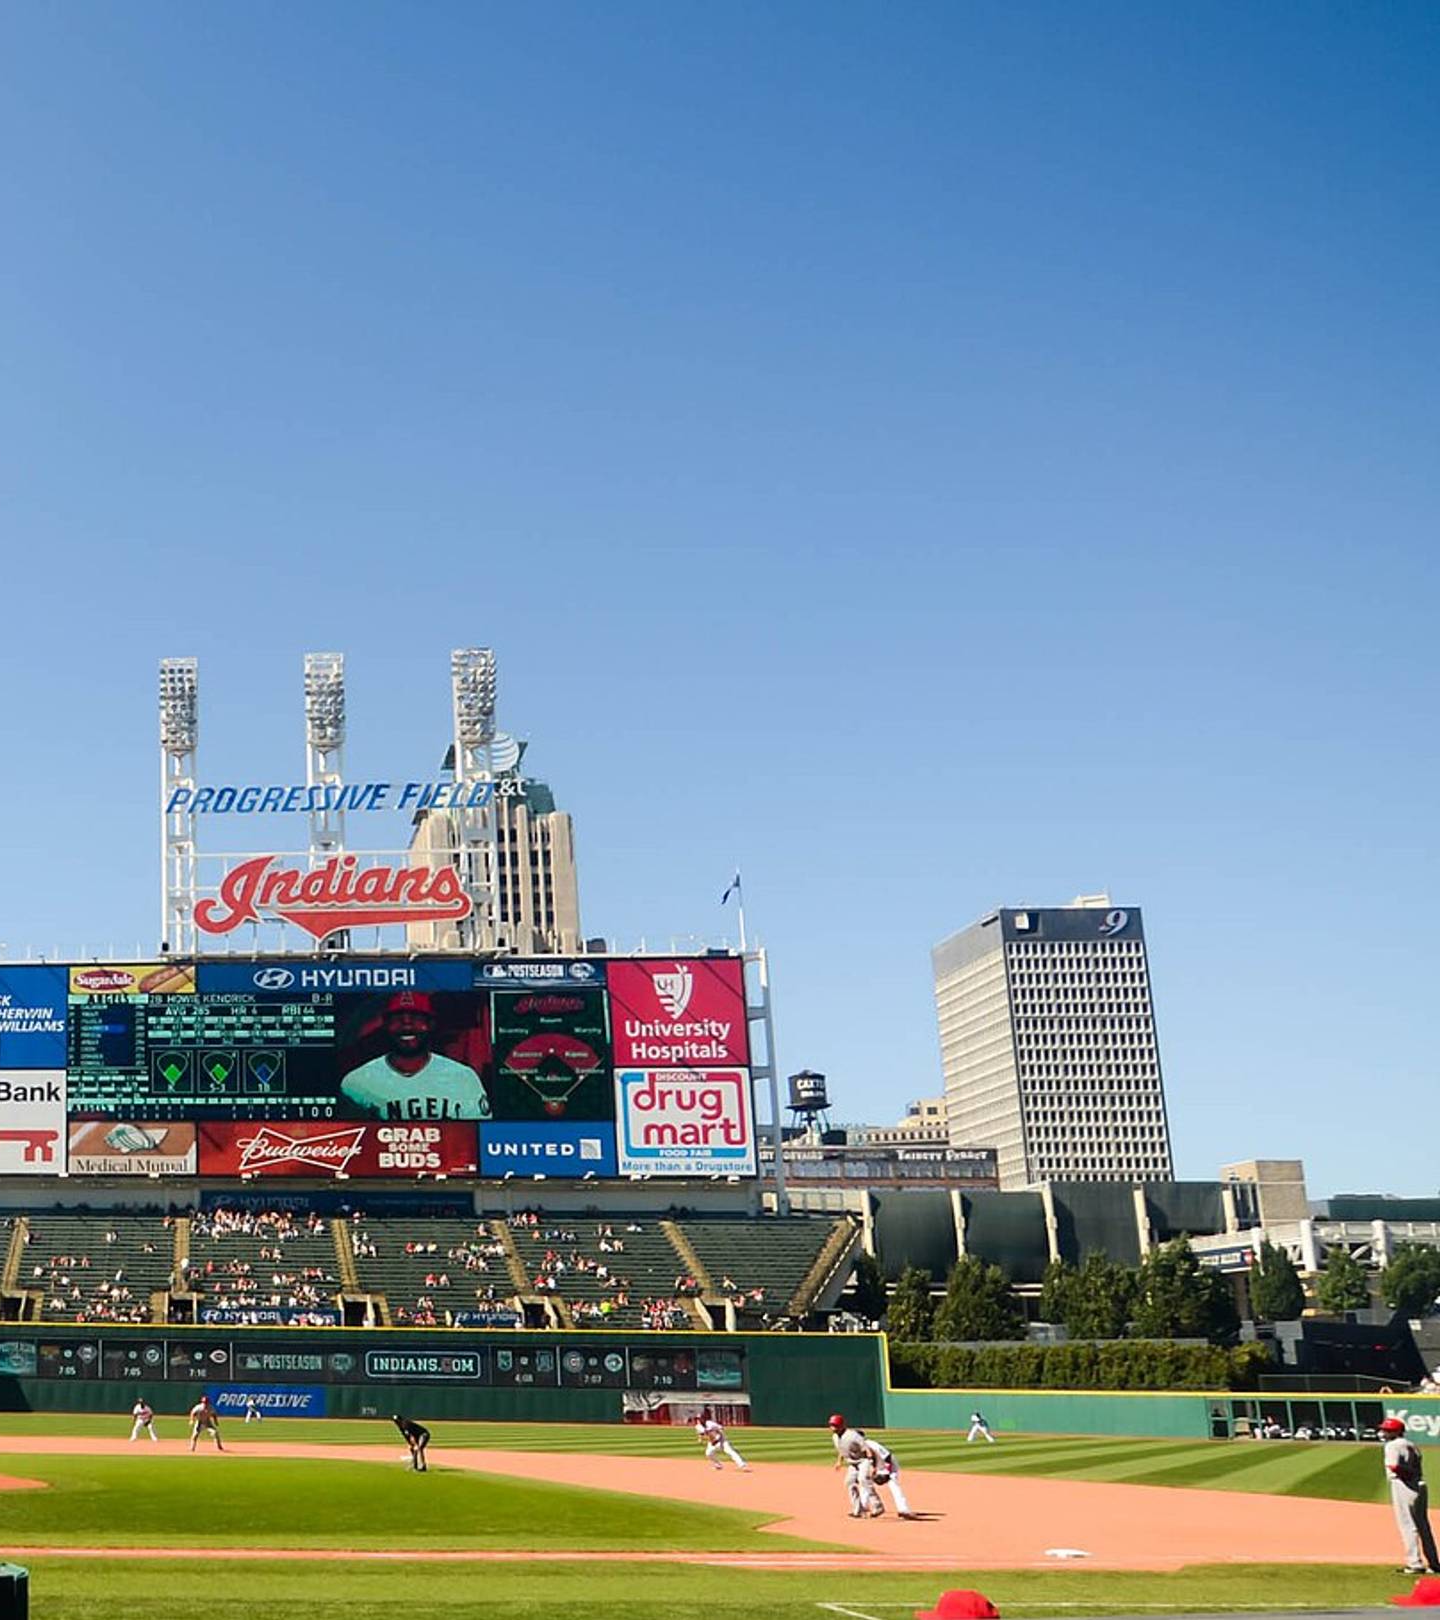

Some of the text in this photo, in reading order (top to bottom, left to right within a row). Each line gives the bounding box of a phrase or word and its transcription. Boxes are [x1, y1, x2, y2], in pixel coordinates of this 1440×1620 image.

[166, 781, 495, 814] PROGRESSIVE FIELD
[194, 856, 472, 934] Indians
[1098, 909, 1128, 937] 9
[301, 969, 416, 989] HYUNDAI
[507, 964, 564, 978] POSTSEASON
[625, 1019, 731, 1041] University
[631, 1040, 729, 1064] Hospitals
[632, 1072, 723, 1120] drug
[377, 1127, 442, 1143] GRAB
[643, 1117, 737, 1145] mart
[237, 1138, 362, 1161] Budweiser
[388, 1142, 431, 1153] SOME
[487, 1143, 575, 1157] UNITED
[76, 1158, 188, 1173] Medical Mutual
[379, 1152, 442, 1168] BUDS
[622, 1161, 652, 1171] More
[655, 1161, 680, 1171] than
[695, 1161, 753, 1173] Drugstore
[263, 1354, 322, 1370] POSTSEASON
